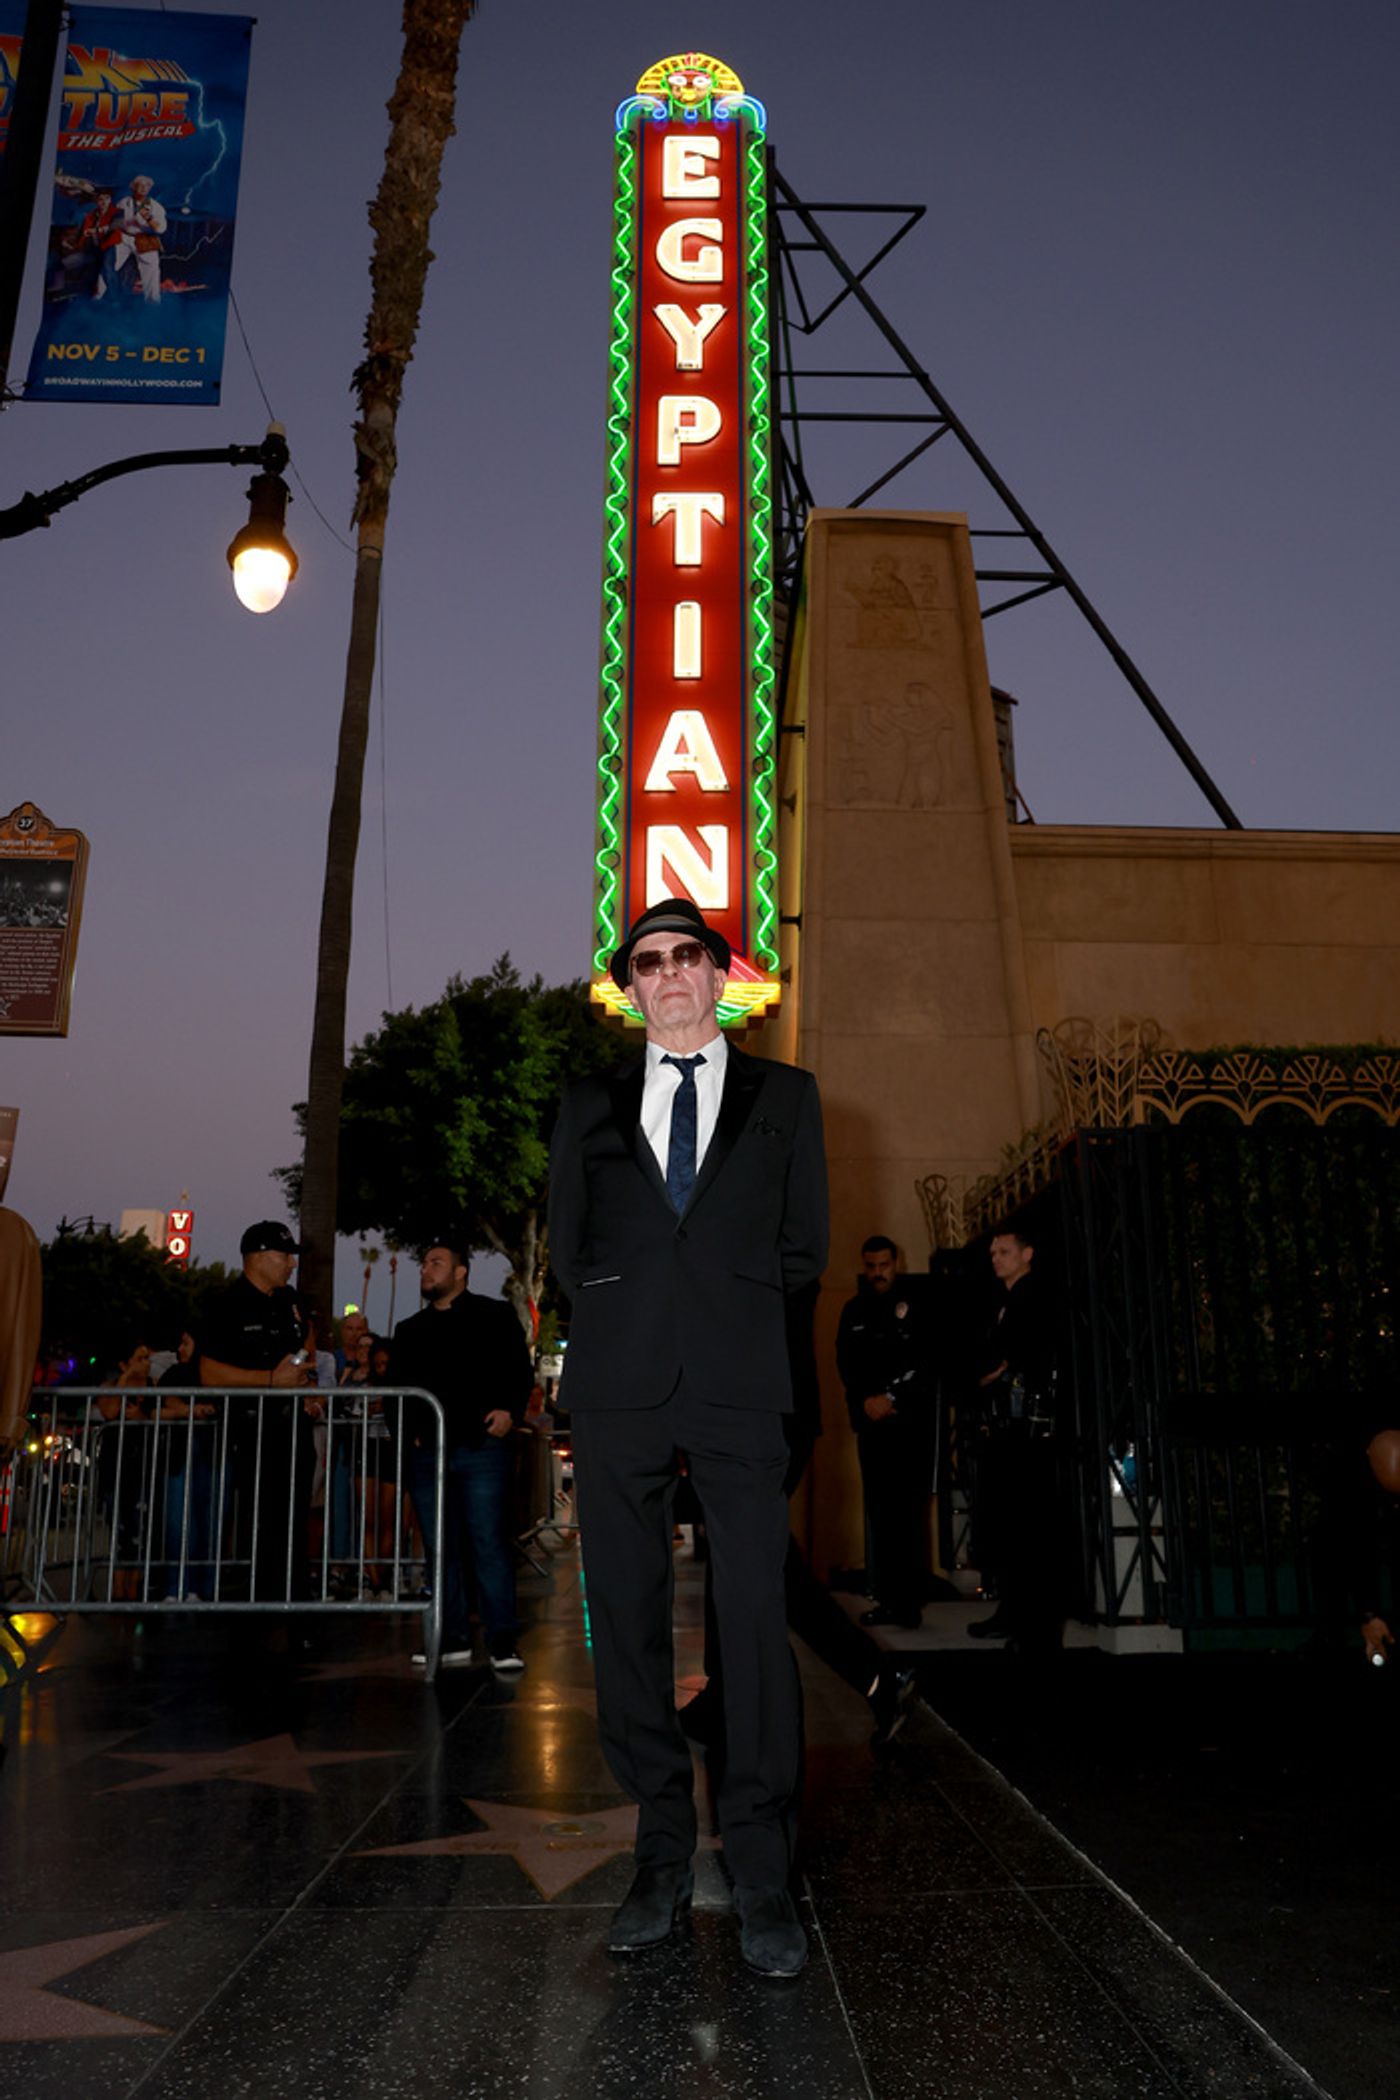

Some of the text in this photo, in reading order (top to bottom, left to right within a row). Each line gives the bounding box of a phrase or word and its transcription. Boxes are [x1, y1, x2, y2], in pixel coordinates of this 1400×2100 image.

[66, 125, 184, 148] THE MUSICAL
[47, 343, 101, 361] NOV
[105, 346, 120, 362] 5
[142, 346, 190, 363] DEC
[195, 347, 206, 364] 1
[643, 135, 729, 909] EGYPTIAN
